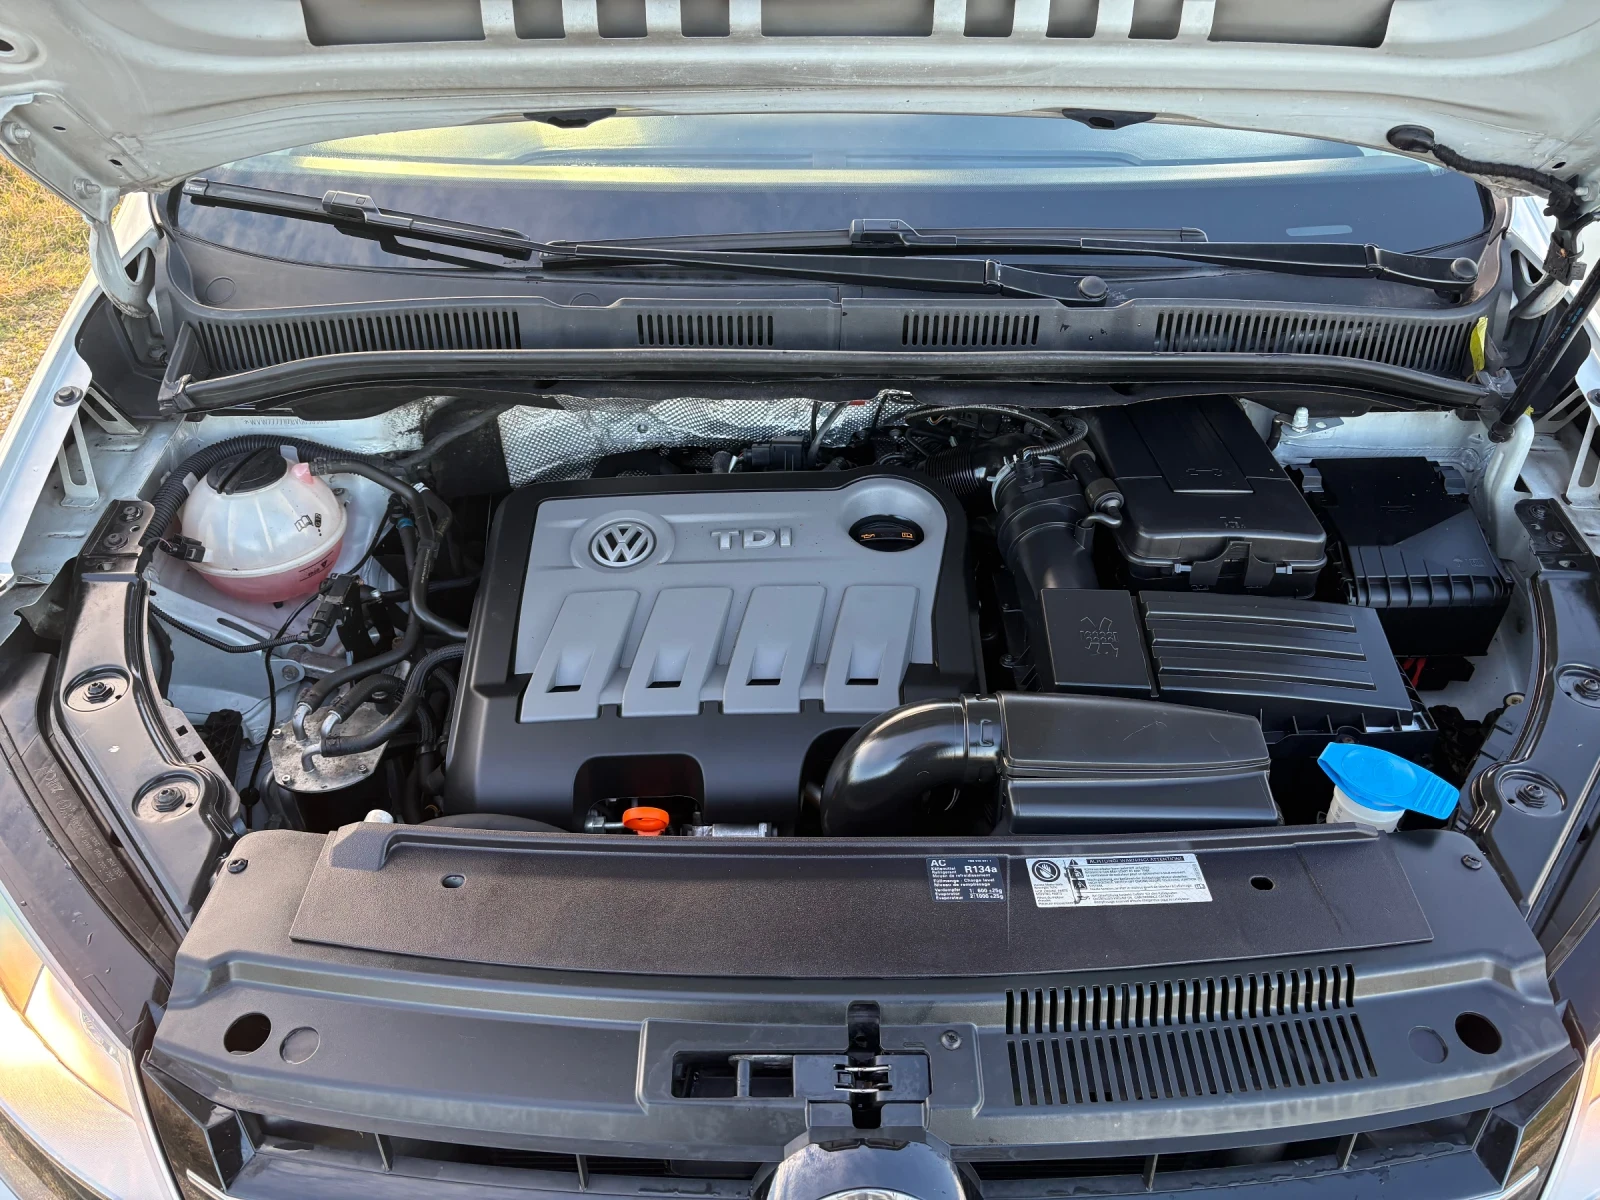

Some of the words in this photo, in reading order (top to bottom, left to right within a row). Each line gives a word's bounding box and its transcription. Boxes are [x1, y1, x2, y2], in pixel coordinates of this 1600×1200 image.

[593, 521, 654, 565] VW
[710, 527, 792, 550] TDI
[931, 859, 946, 867] AC
[964, 865, 998, 873] R134a
